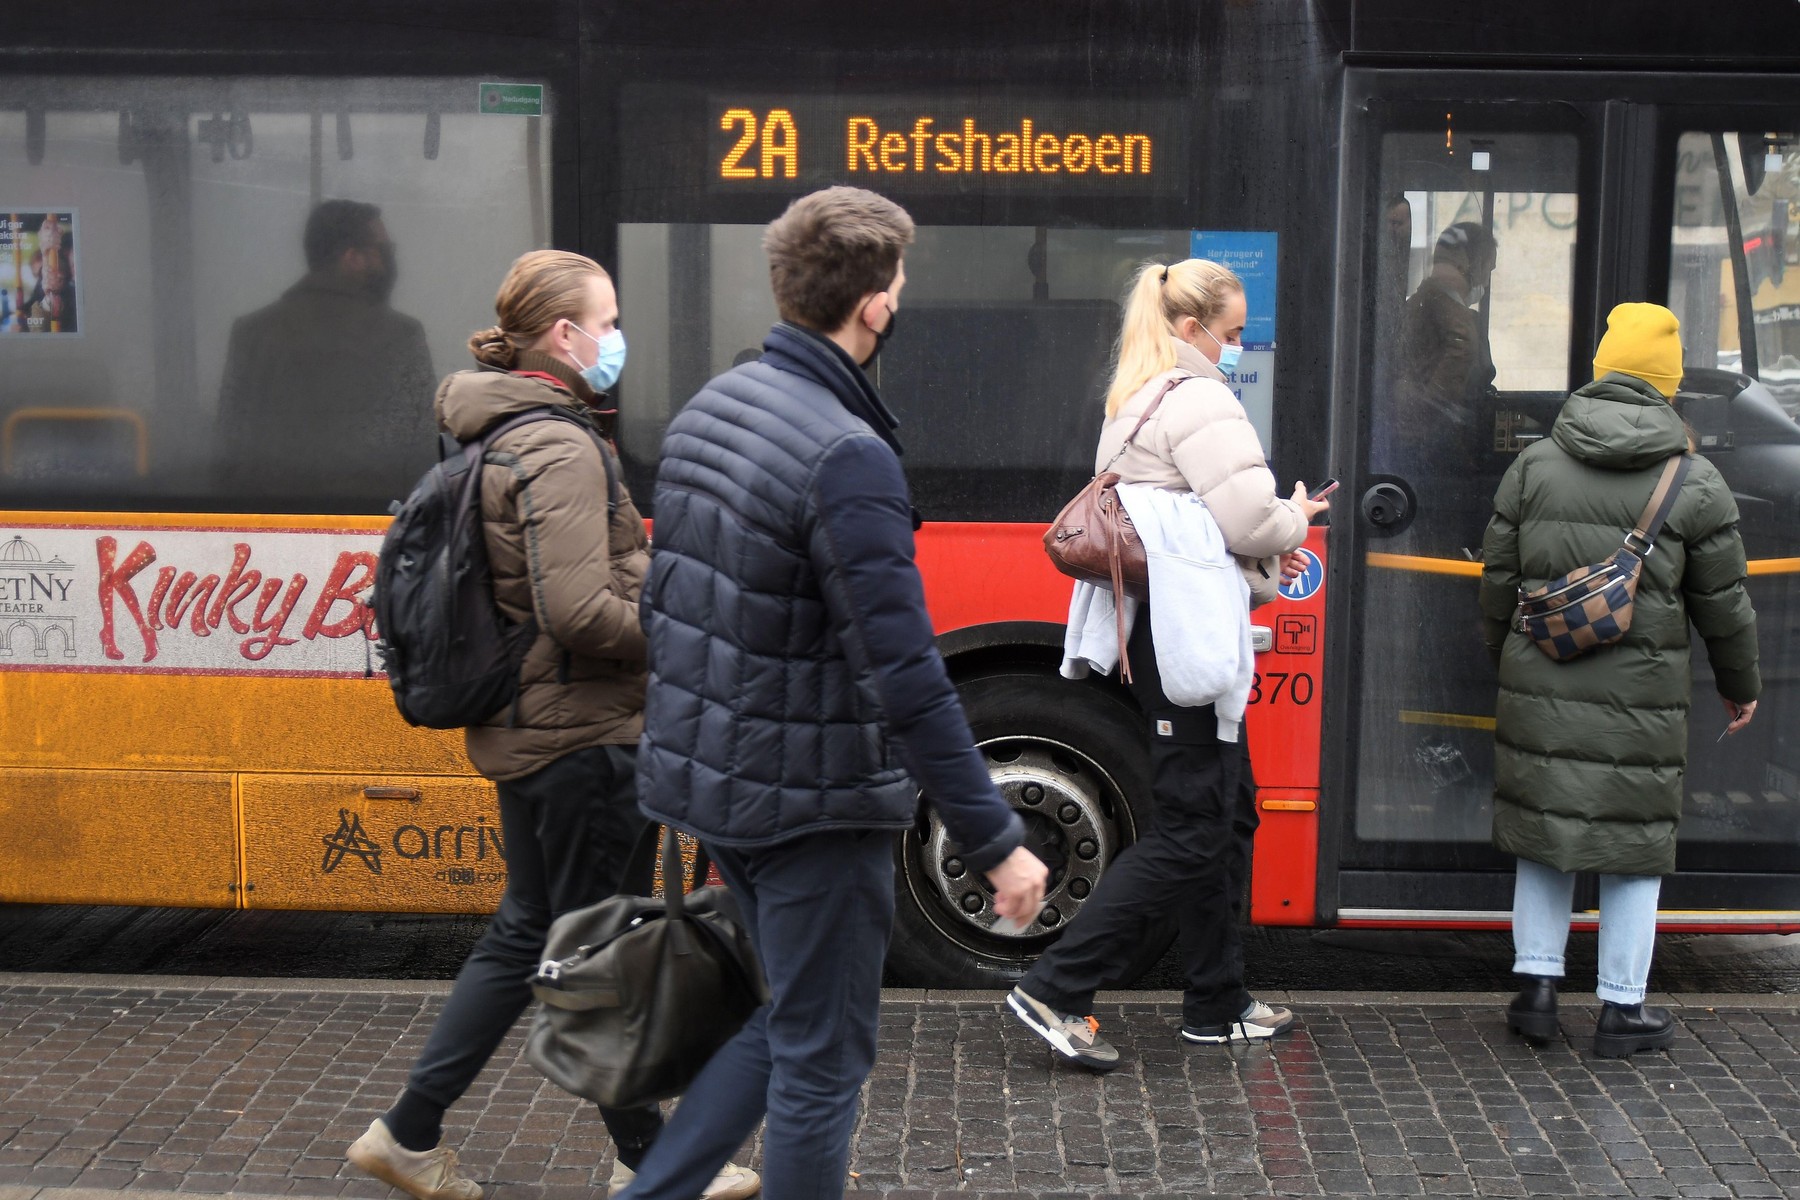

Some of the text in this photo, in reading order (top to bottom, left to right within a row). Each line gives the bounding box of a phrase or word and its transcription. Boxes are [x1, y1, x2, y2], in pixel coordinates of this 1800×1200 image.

[720, 109, 1152, 178] 2A Refshaleøen
[1224, 248, 1253, 260] bruger
[1255, 249, 1264, 258] vi
[1241, 371, 1258, 384] ud
[96, 535, 307, 664] Kinky
[393, 816, 506, 859] arriv
